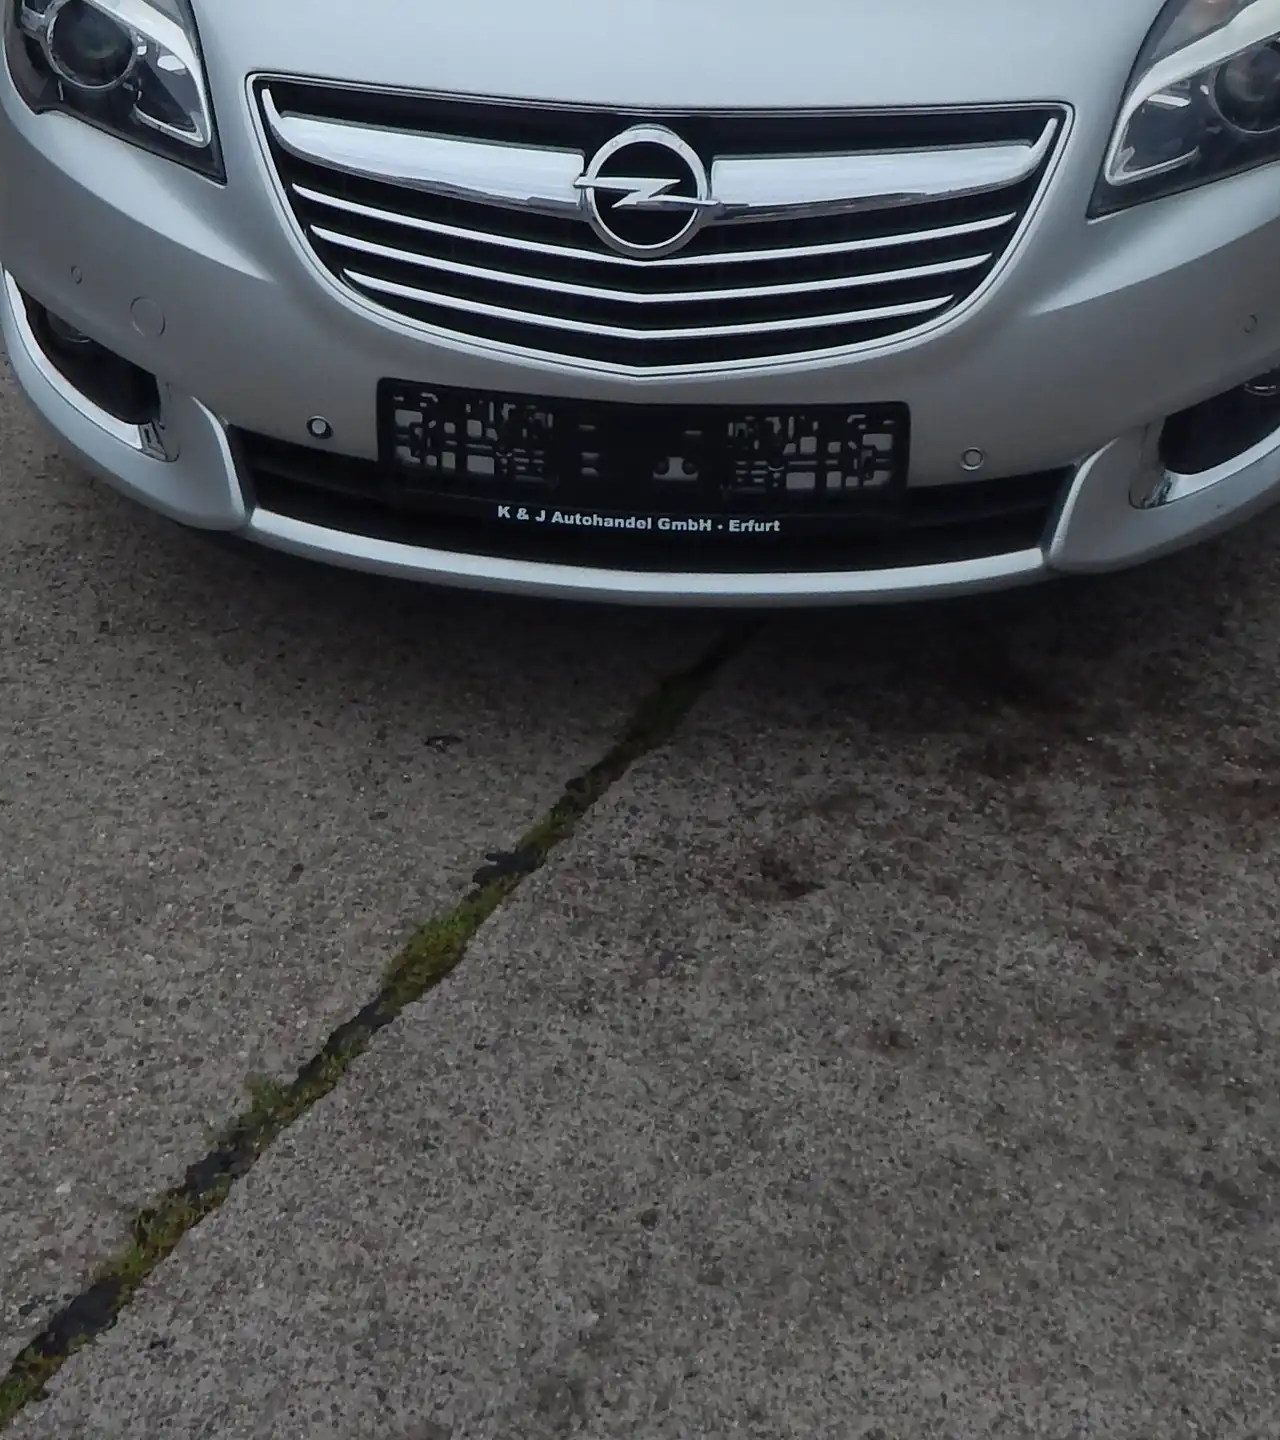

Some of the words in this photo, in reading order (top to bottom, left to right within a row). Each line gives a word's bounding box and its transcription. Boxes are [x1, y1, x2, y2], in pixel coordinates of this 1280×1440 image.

[497, 505, 511, 519] K
[516, 507, 530, 521] &
[535, 509, 546, 523] J
[551, 511, 652, 530] Autohandel
[658, 518, 712, 531] GmbH
[729, 519, 780, 532] Erfurt
